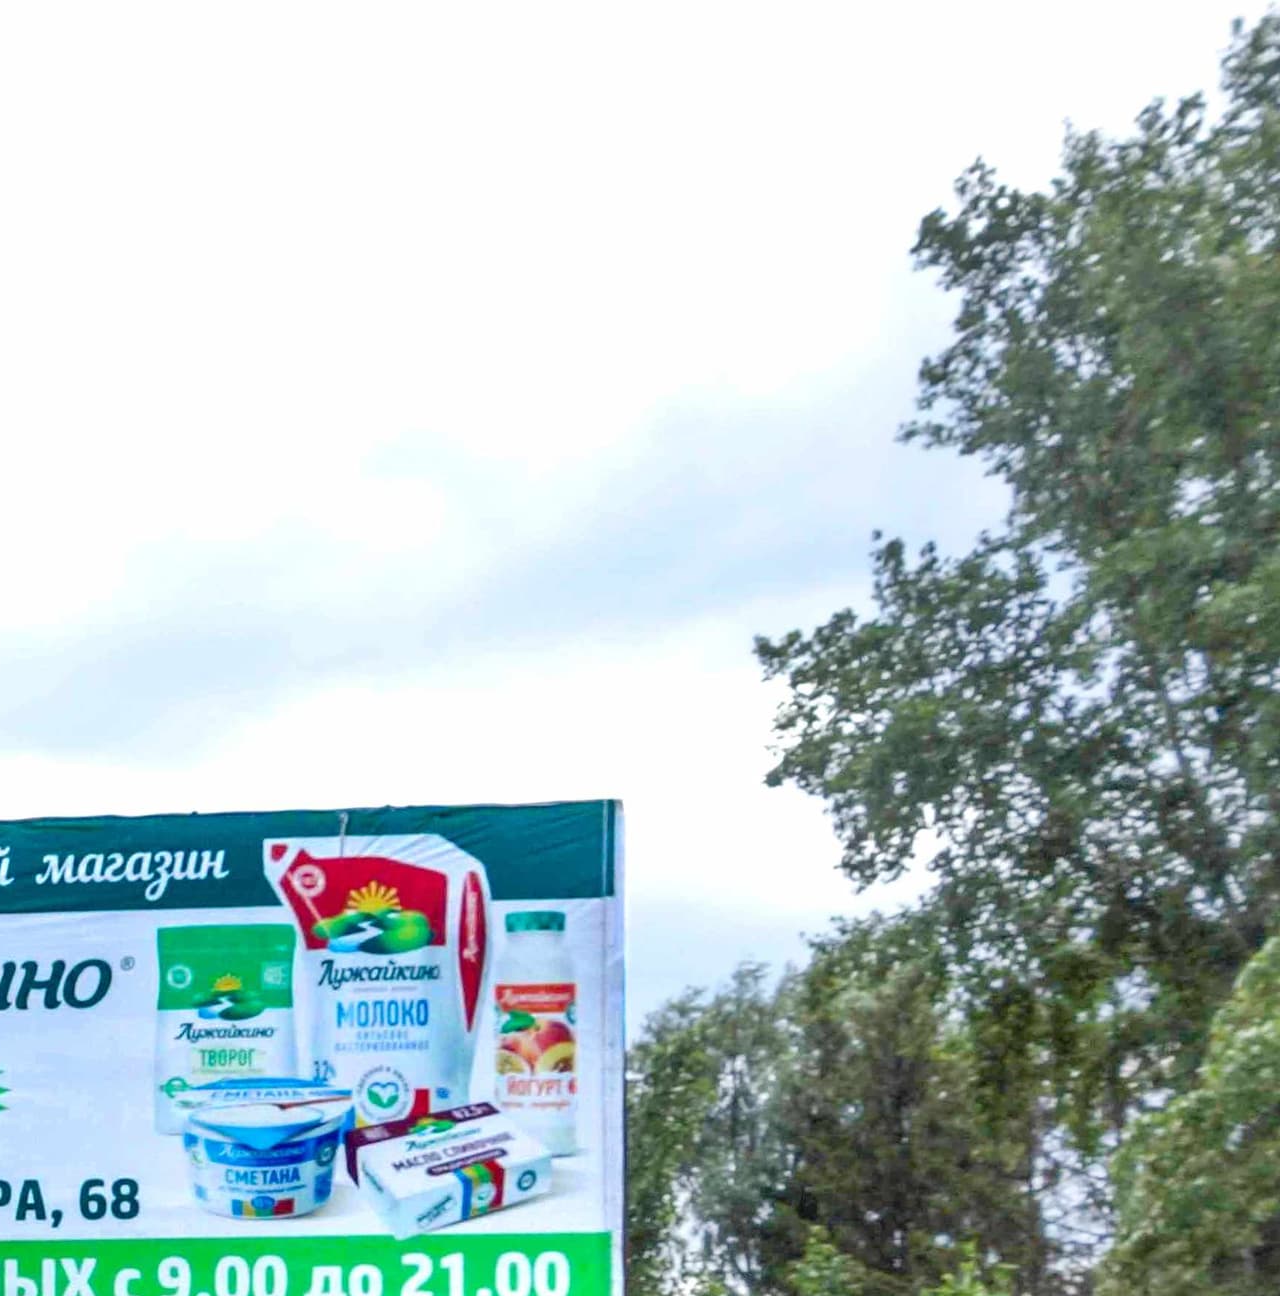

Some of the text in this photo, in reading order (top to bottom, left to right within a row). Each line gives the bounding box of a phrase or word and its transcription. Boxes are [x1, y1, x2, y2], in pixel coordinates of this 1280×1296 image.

[36, 847, 229, 901] магазин
[317, 959, 441, 990] Лужайкино
[336, 999, 430, 1027] МОЛОКО
[174, 1023, 275, 1043] Лужайкино
[199, 1048, 257, 1067] ТВОРОГ
[225, 1167, 301, 1186] СМЕТАНА
[78, 1178, 141, 1220] 68
